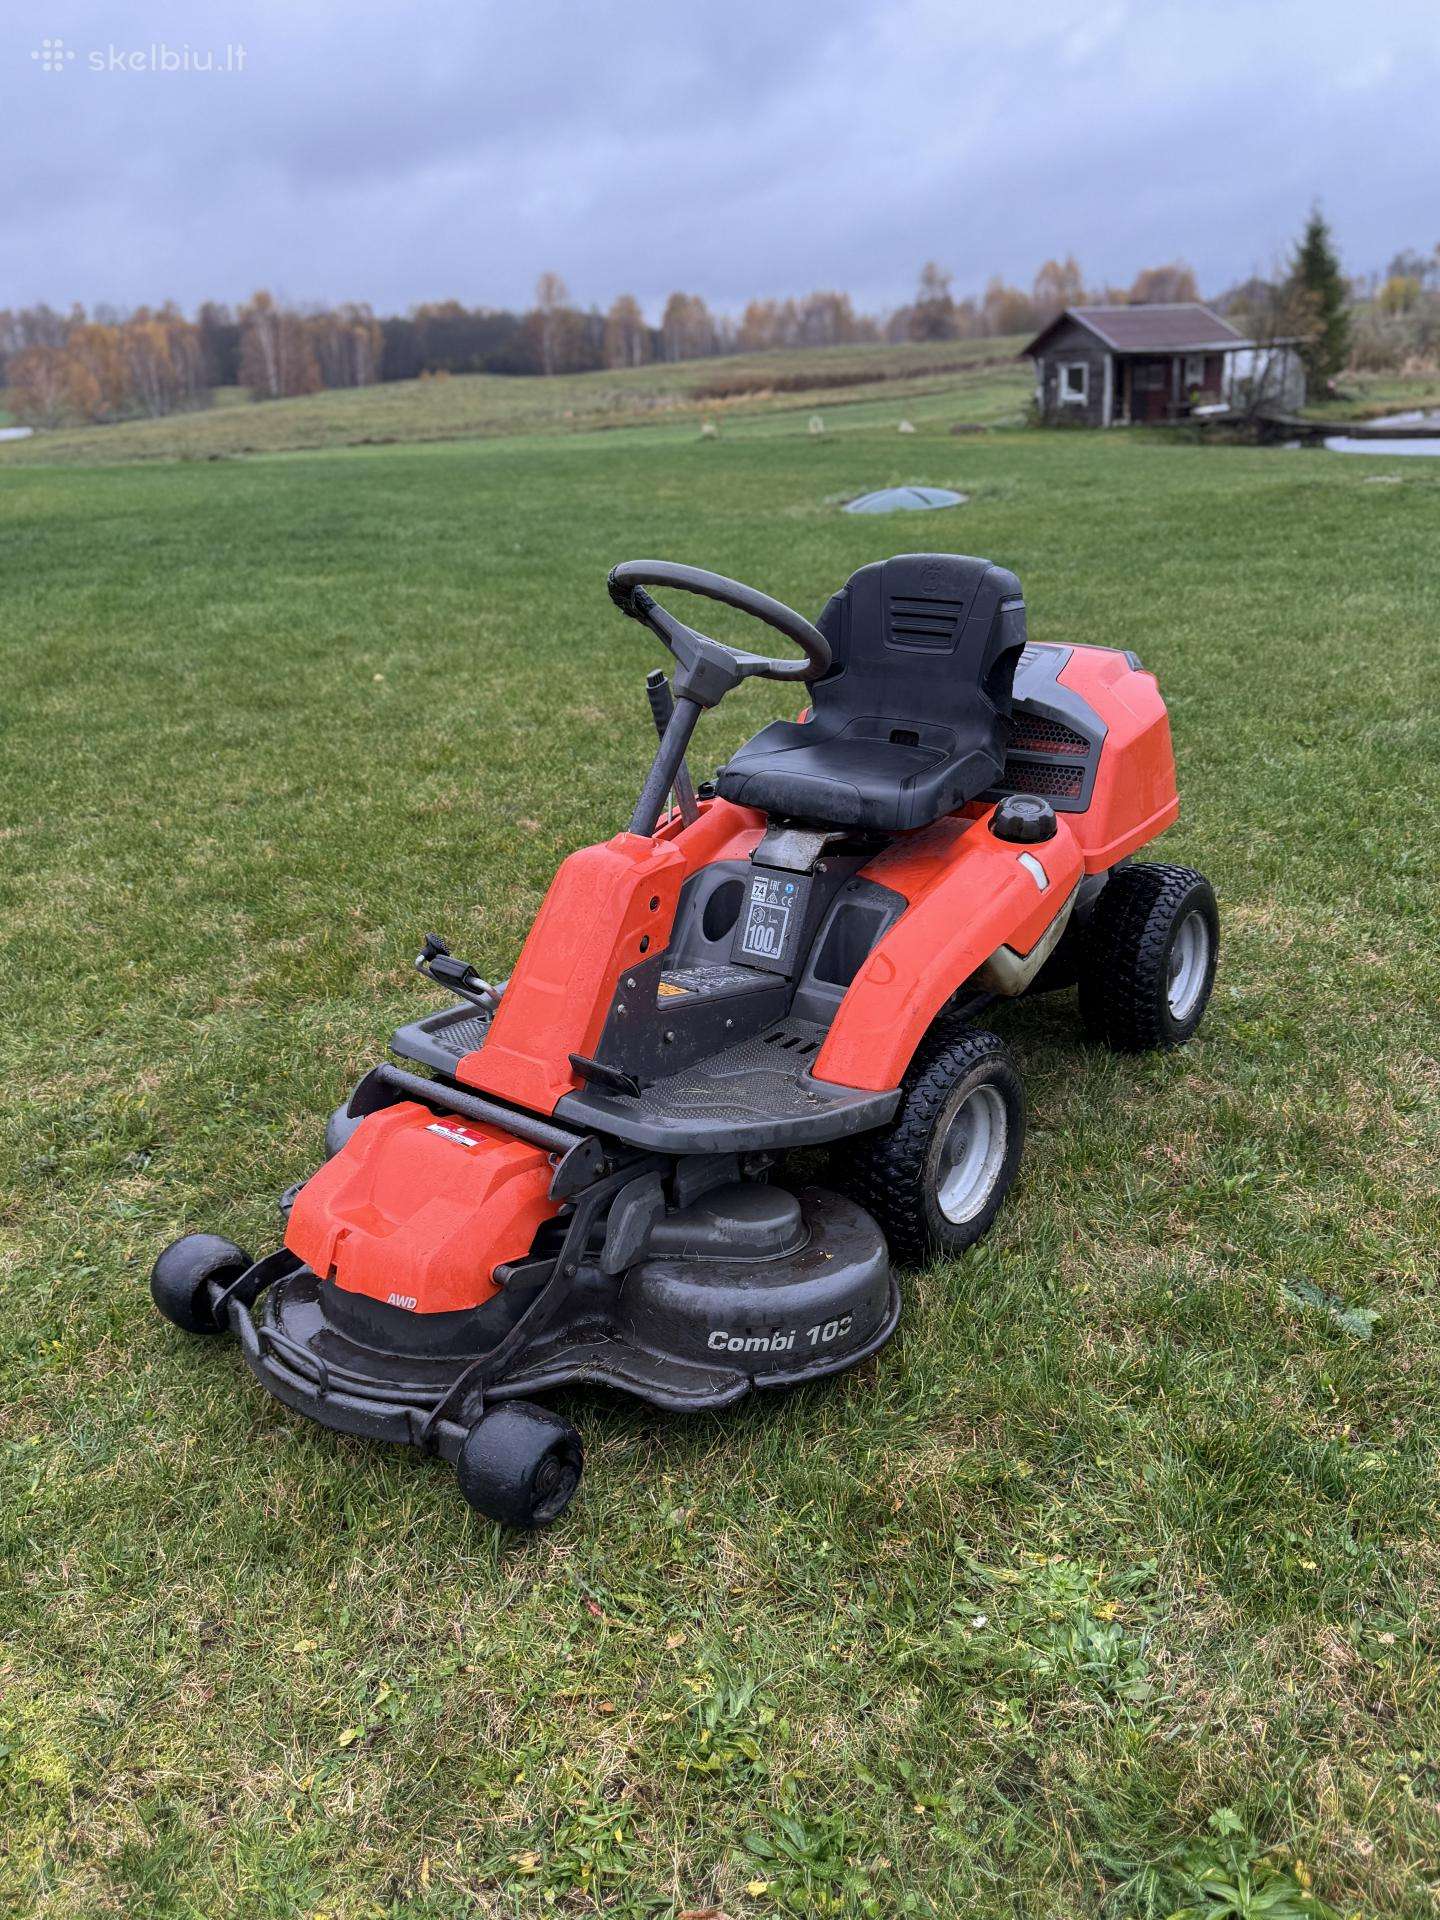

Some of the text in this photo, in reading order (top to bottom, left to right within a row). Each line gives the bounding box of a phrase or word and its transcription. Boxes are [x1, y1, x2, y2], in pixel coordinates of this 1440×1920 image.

[754, 885, 765, 896] 74
[749, 924, 775, 952] 100
[387, 1292, 418, 1309] AWD
[707, 1330, 796, 1352] Combi
